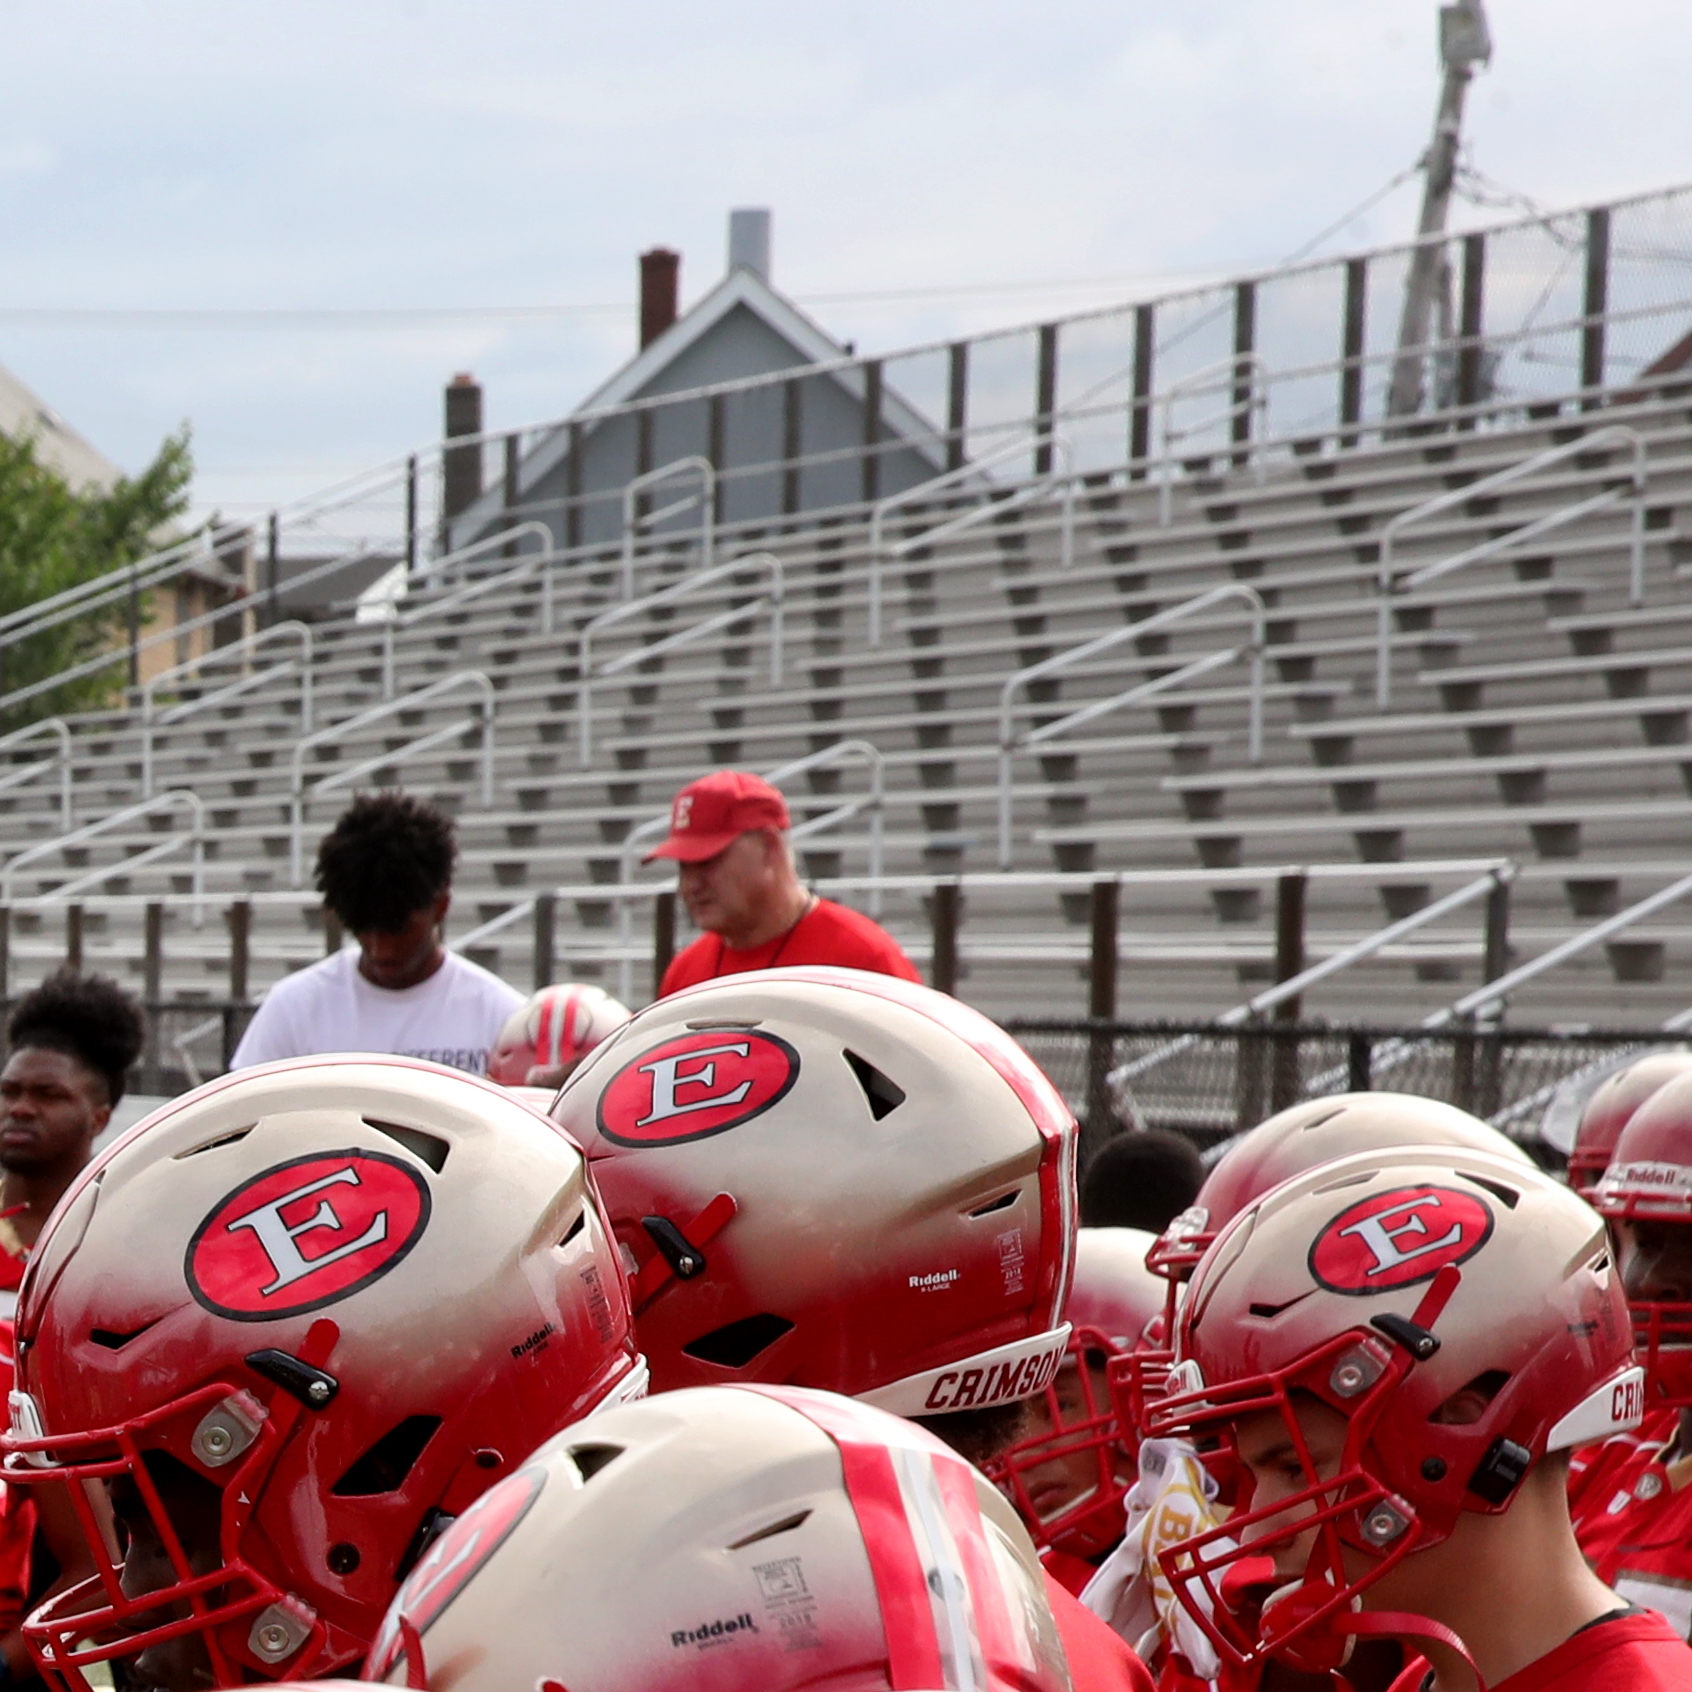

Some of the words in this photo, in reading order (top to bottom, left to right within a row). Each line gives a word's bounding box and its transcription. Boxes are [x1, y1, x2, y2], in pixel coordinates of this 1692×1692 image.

[636, 1042, 754, 1128] E
[227, 1166, 389, 1297] E
[1338, 1194, 1463, 1277] E
[909, 1269, 961, 1288] Riddell
[511, 1323, 555, 1360] Riddell
[671, 1613, 755, 1648] Riddell
